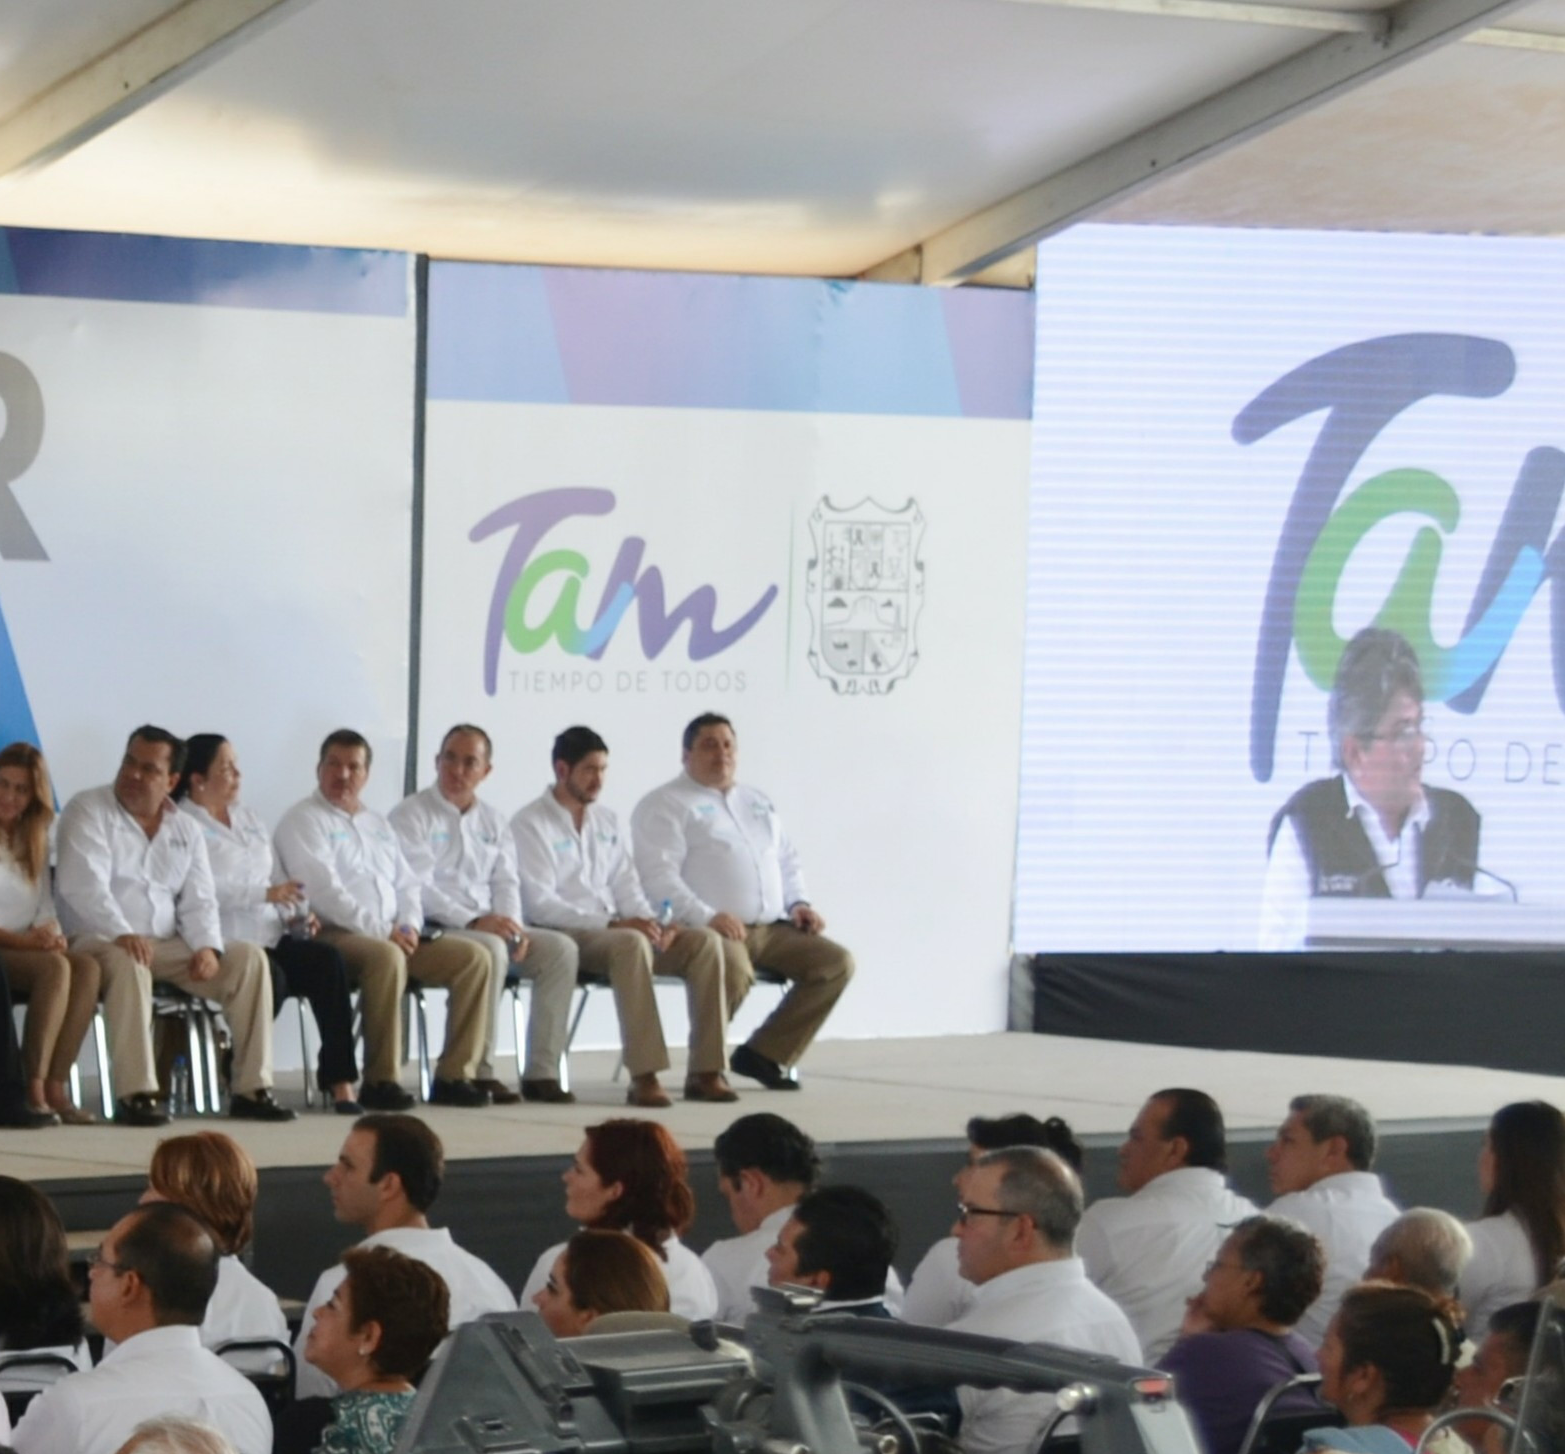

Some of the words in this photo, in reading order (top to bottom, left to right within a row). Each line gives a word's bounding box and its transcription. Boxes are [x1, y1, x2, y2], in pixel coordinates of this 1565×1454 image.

[468, 486, 778, 697] Tam
[508, 669, 604, 693] TIEMPO
[616, 669, 649, 693] DE
[660, 669, 747, 693] TODOS
[1504, 741, 1564, 785] DE
